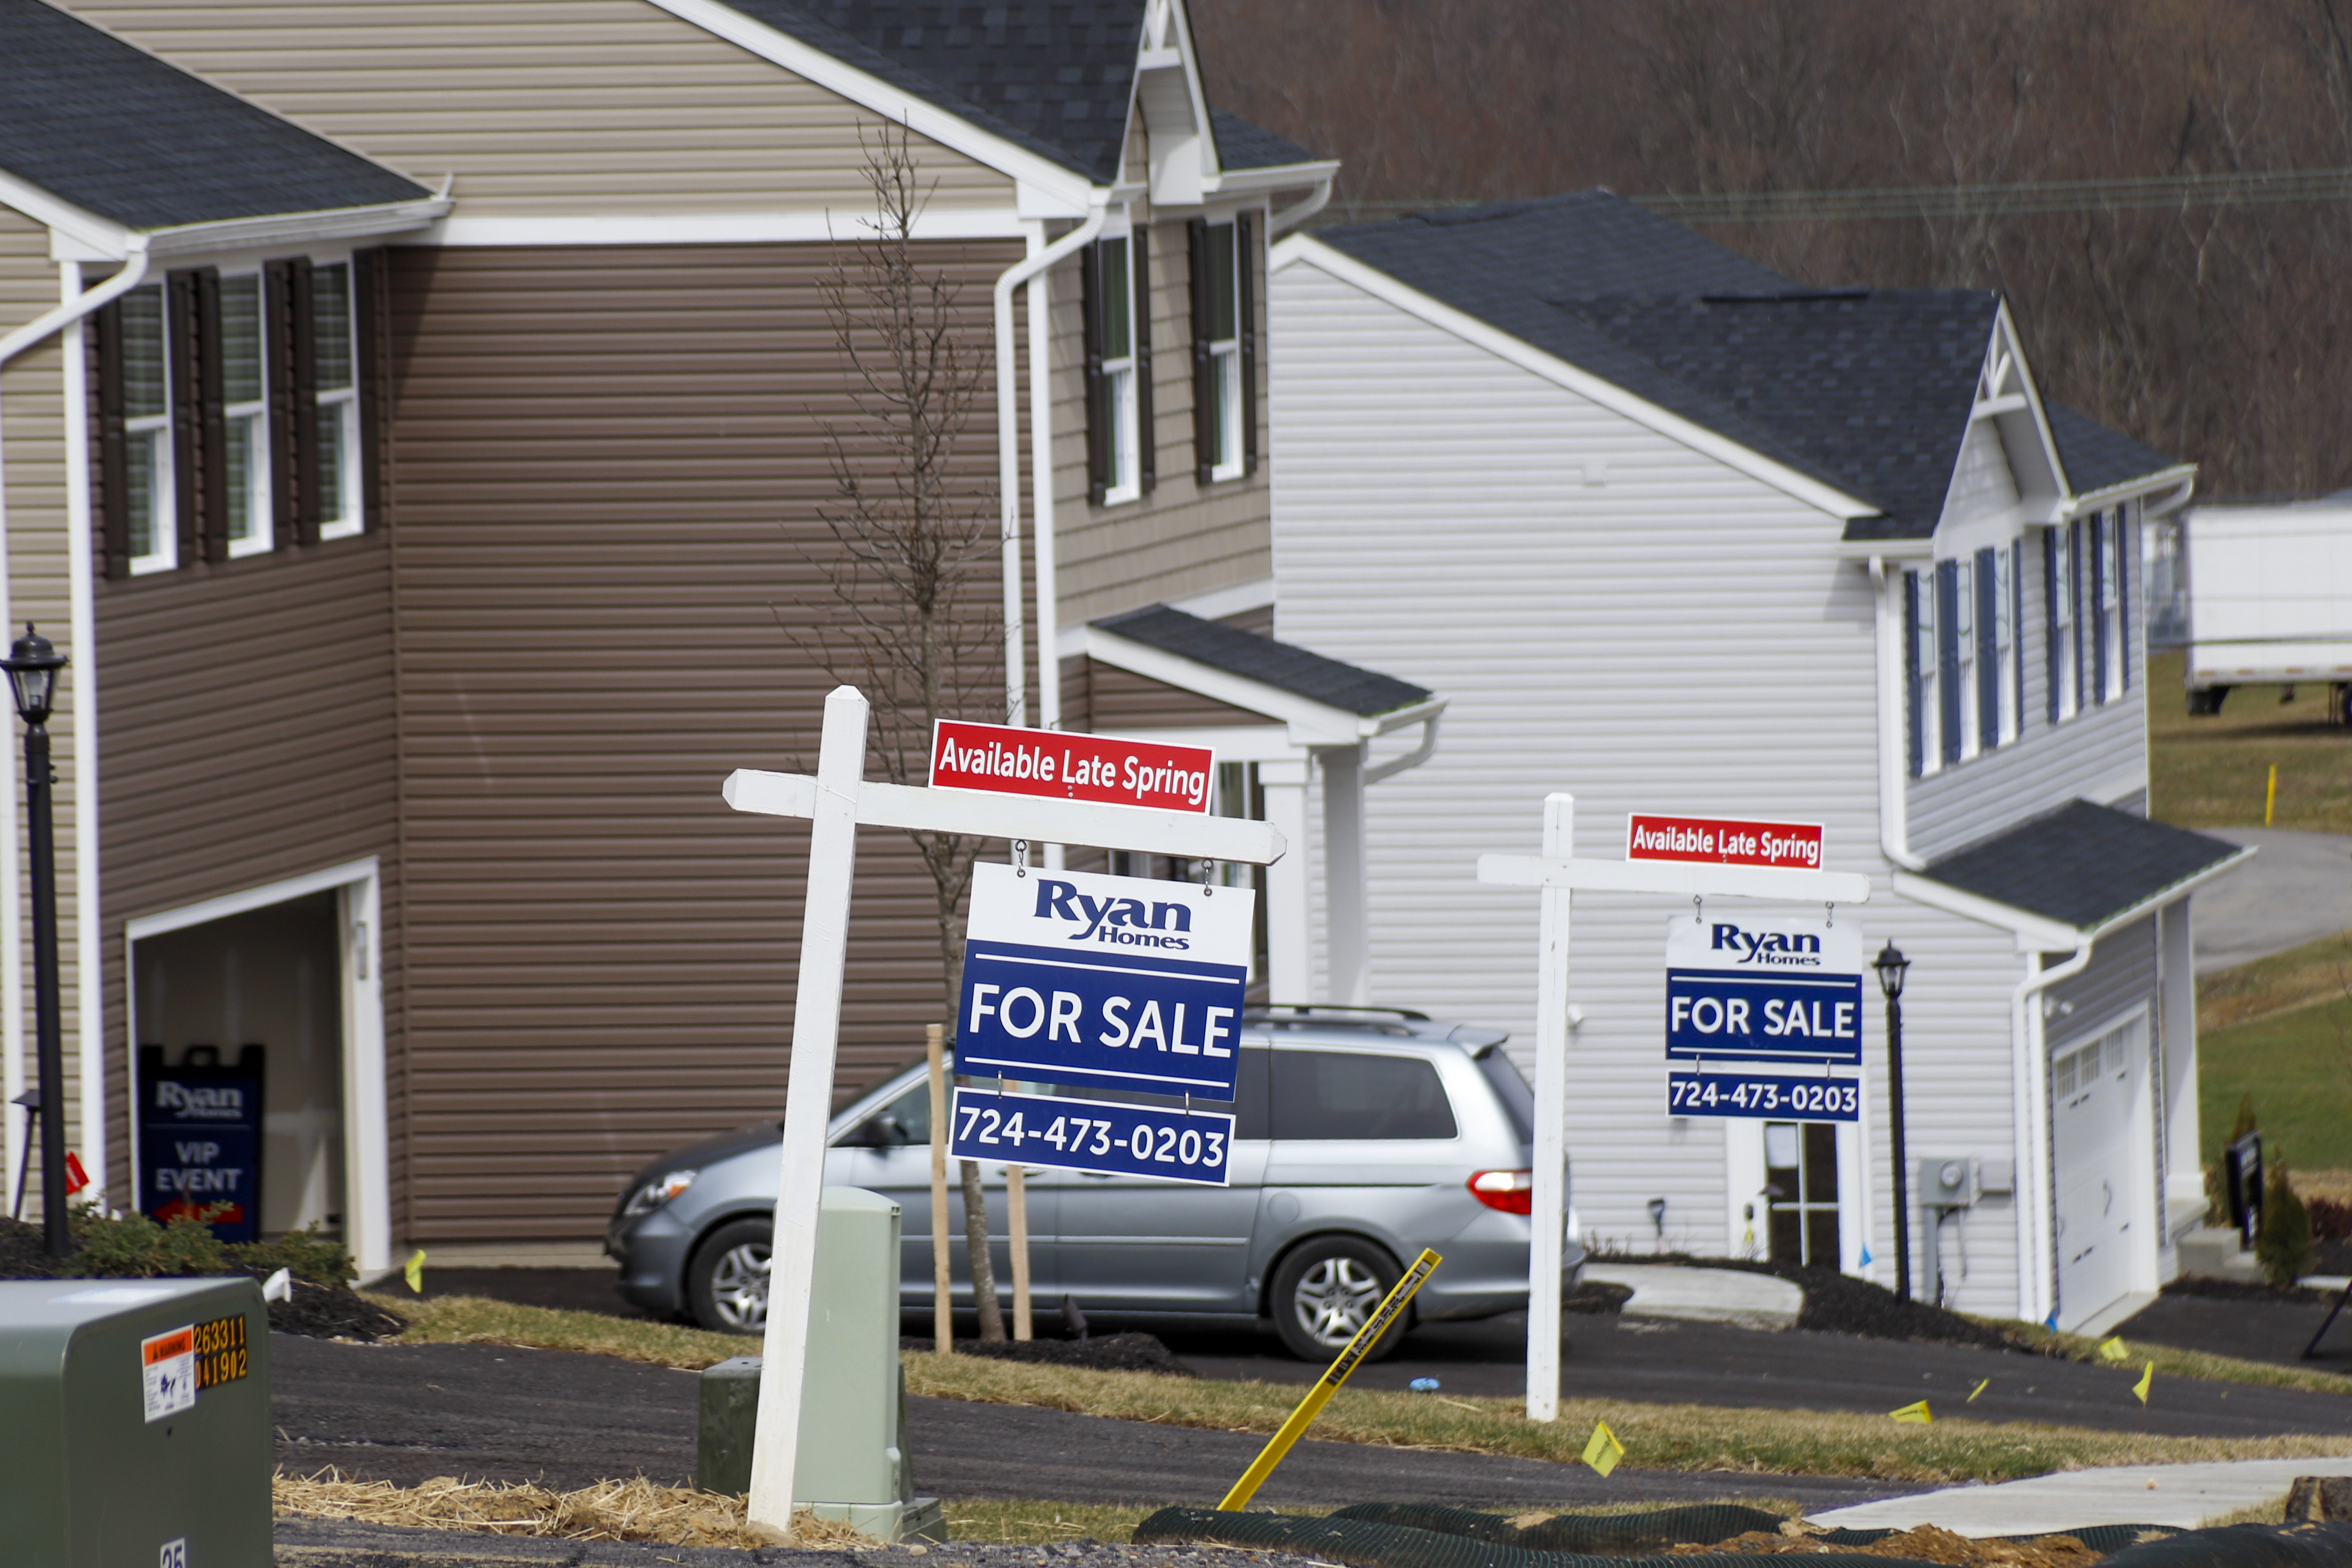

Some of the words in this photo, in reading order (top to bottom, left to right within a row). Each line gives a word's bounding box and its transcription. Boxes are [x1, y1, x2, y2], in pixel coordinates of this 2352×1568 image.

[939, 737, 1055, 782] Available
[1061, 748, 1116, 788] Late
[1121, 755, 1206, 806] Spring
[1632, 824, 1714, 854] Available
[1717, 829, 1757, 856] Late
[1760, 831, 1819, 866] Spring
[1034, 879, 1191, 940] Ryan
[1098, 925, 1190, 951] Homes
[1711, 923, 1820, 963] Ryan
[1756, 952, 1821, 966] Homes
[969, 983, 1083, 1044] FOR
[1098, 995, 1234, 1059] SALE
[1671, 996, 1751, 1034] FOR
[1763, 999, 1855, 1038] SALE
[156, 1081, 243, 1118] Ryan
[1671, 1081, 1857, 1113] 724-473-0203
[175, 1141, 219, 1164] VIP
[958, 1106, 1225, 1168] 724-473-0203
[156, 1168, 242, 1192] EVENT
[194, 1315, 245, 1355] 263311
